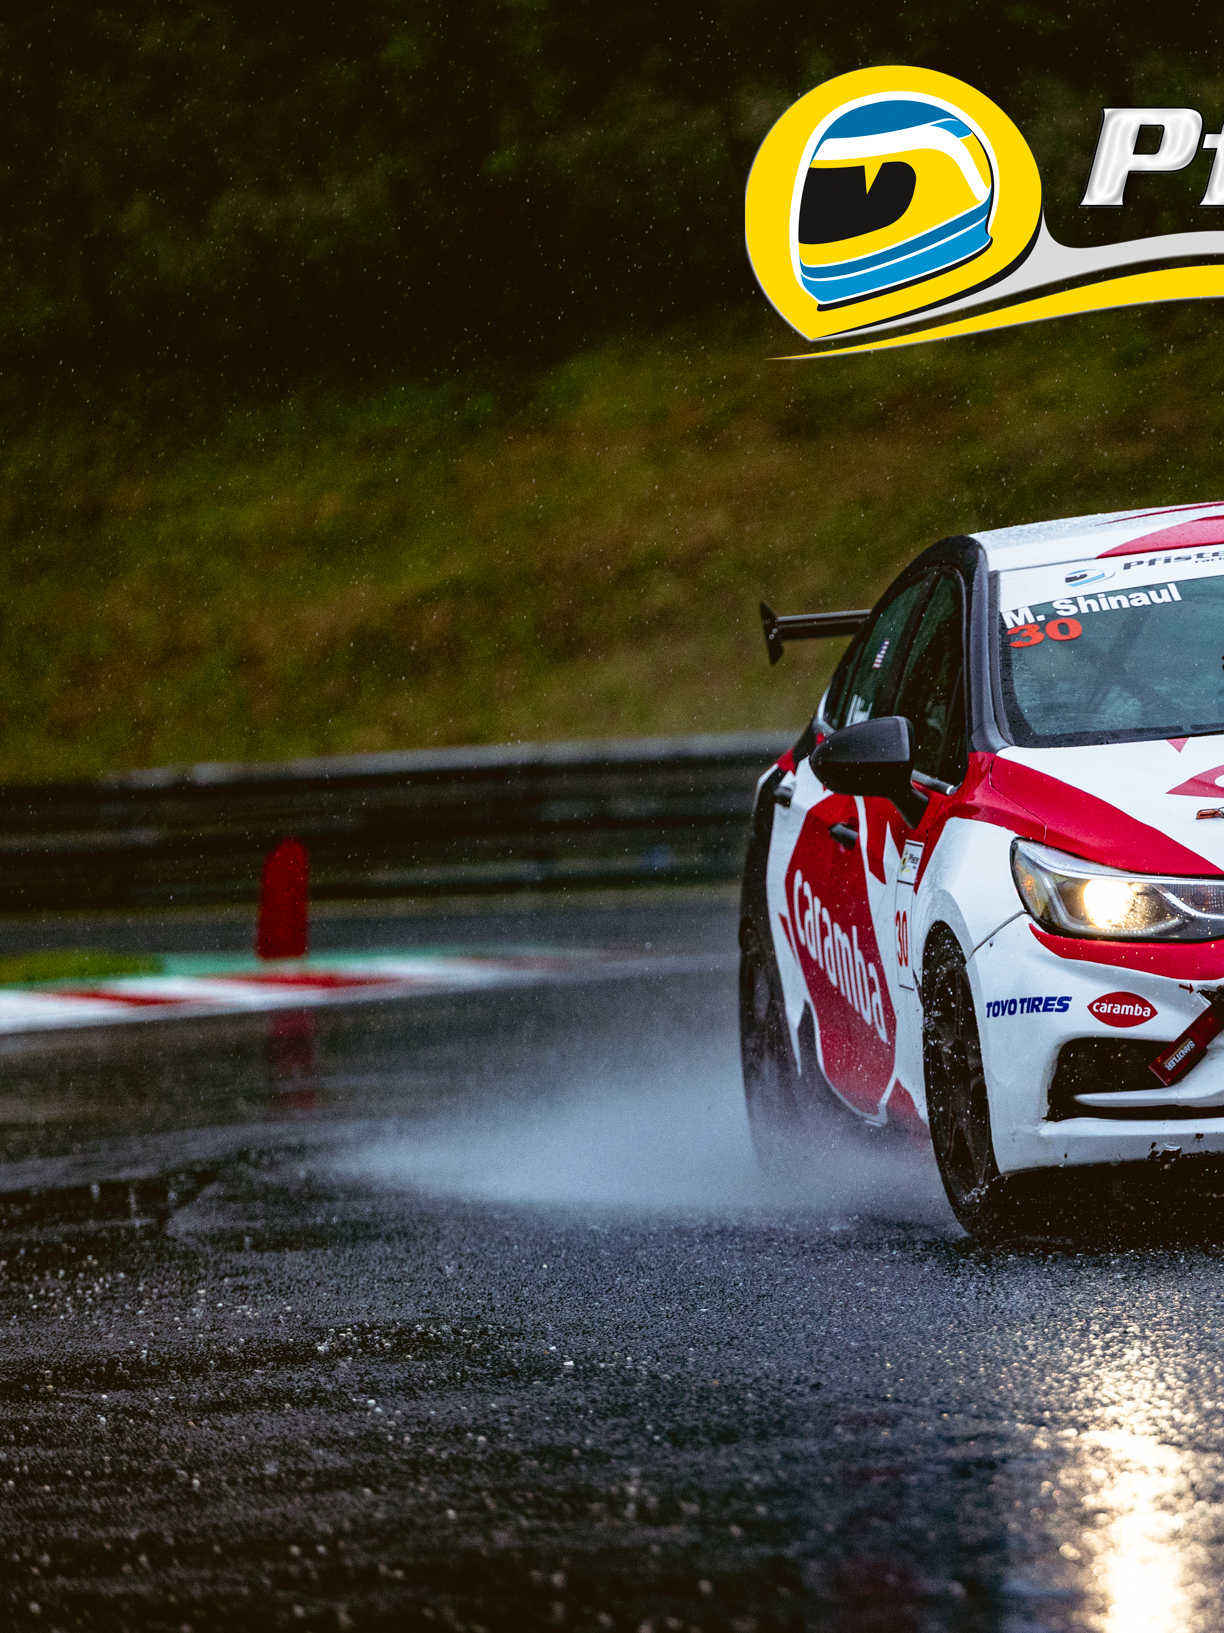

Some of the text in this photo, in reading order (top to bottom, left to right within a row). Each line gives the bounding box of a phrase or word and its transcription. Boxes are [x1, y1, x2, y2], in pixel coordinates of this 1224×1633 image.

[1001, 583, 1182, 629] M. Shinaul
[1006, 618, 1083, 648] 30
[896, 910, 909, 967] 30
[986, 996, 1072, 1018] TOYO TIRES
[1092, 1001, 1151, 1017] caramba
